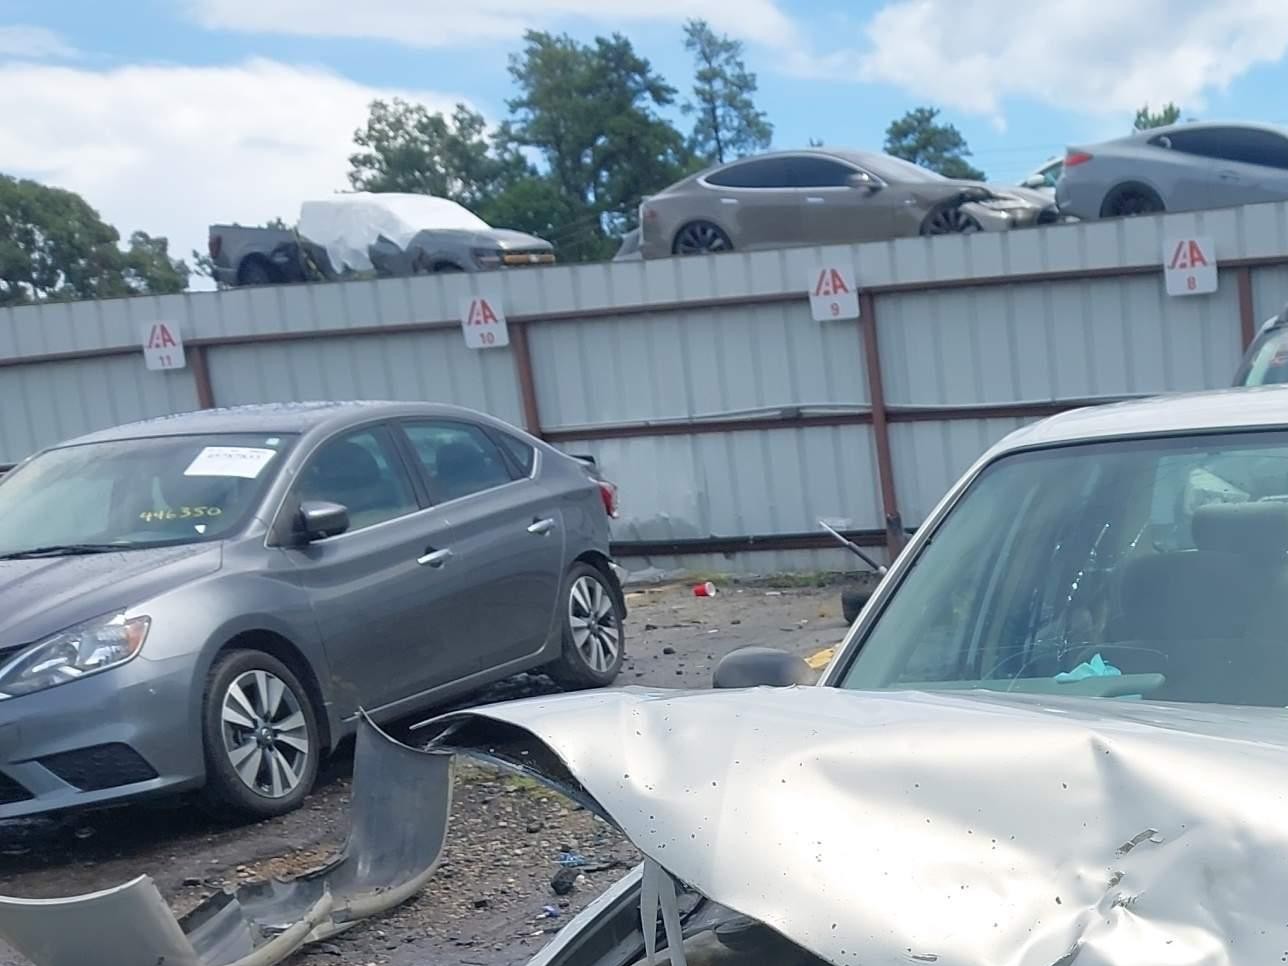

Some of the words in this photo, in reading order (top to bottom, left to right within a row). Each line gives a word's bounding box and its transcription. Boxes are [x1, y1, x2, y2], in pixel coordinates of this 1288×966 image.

[1187, 275, 1197, 290] 8
[831, 302, 840, 317] 9
[479, 332, 496, 345] 10
[159, 355, 173, 367] 11
